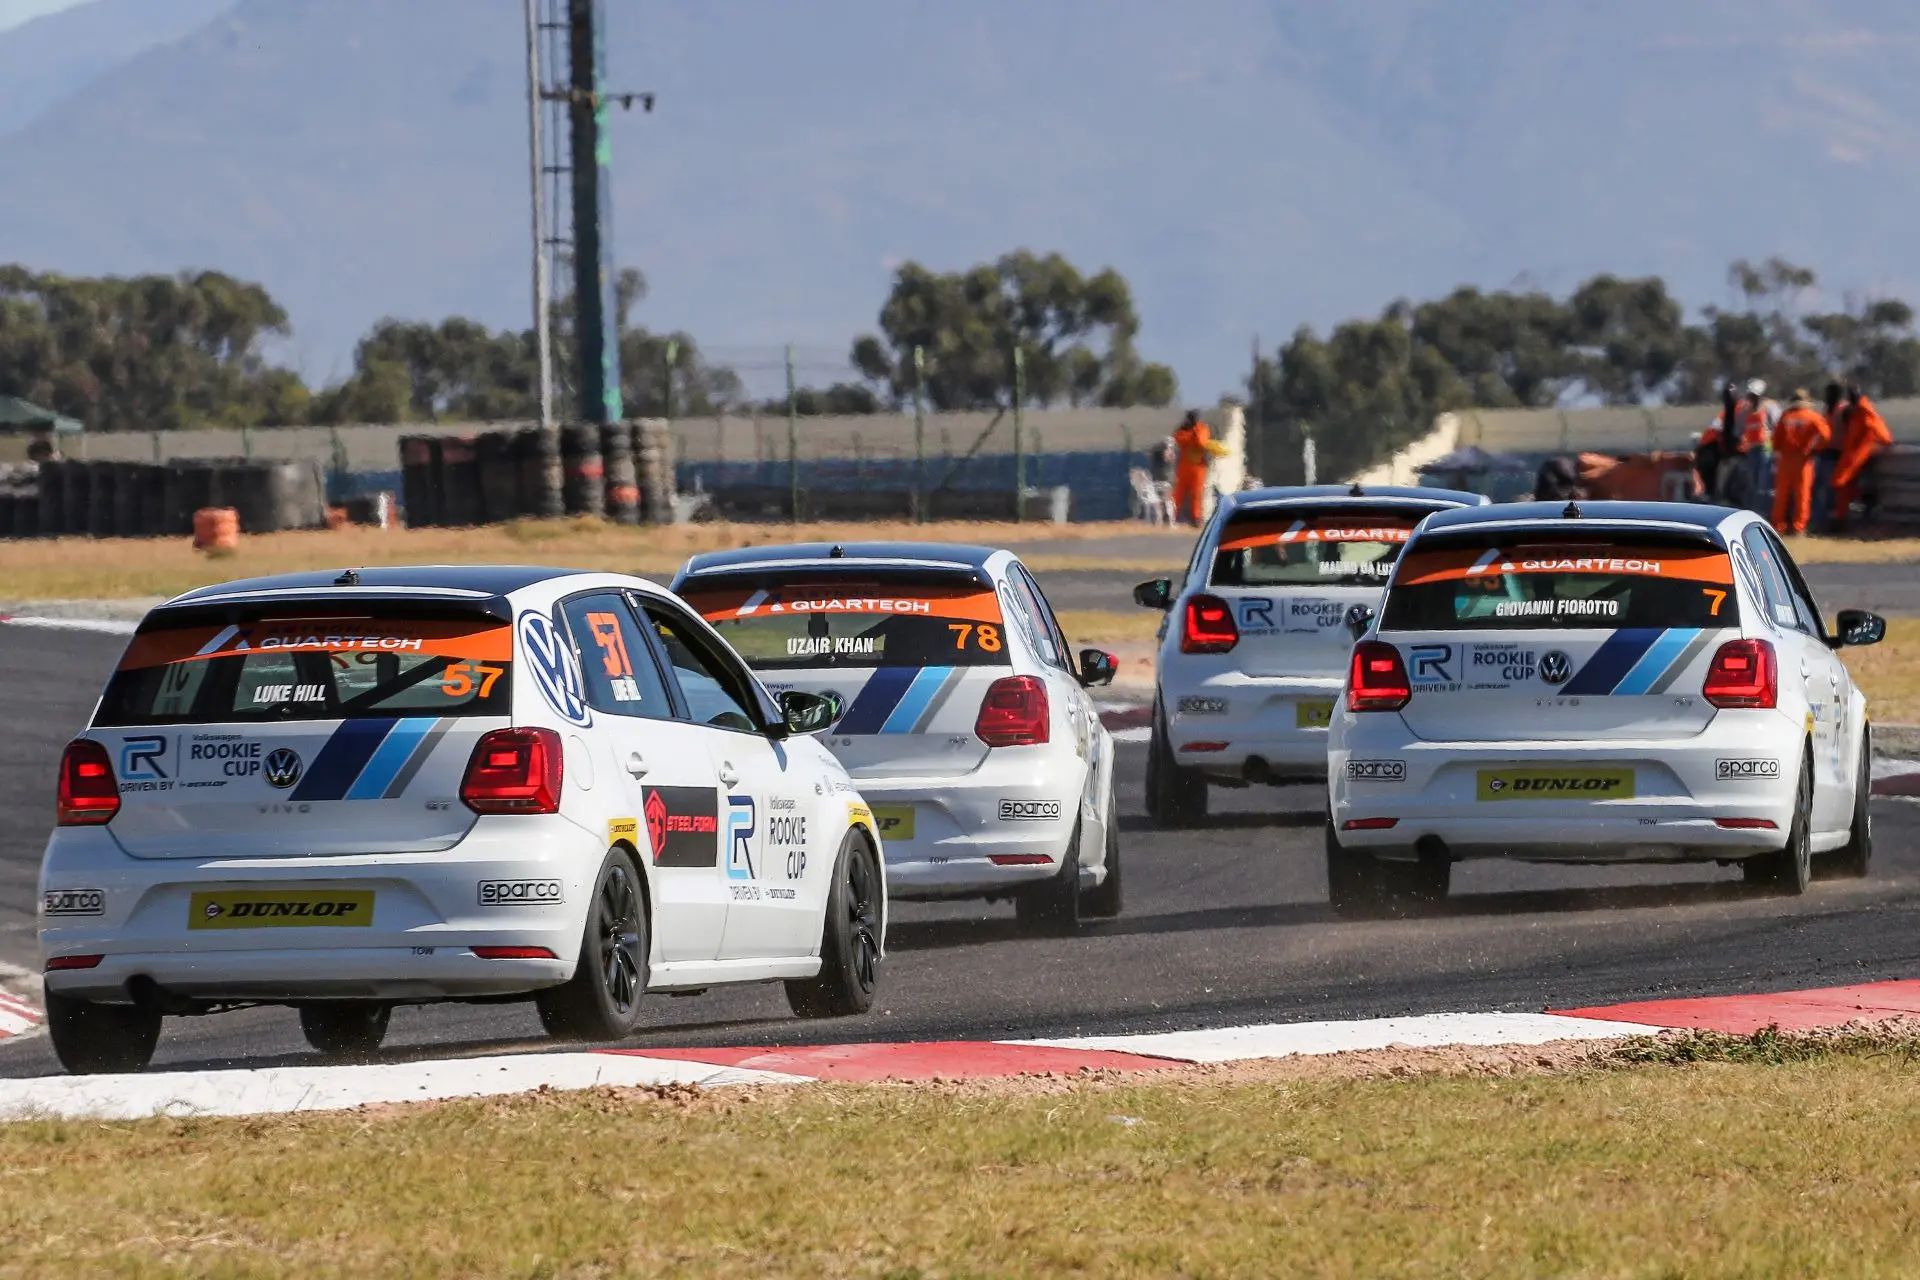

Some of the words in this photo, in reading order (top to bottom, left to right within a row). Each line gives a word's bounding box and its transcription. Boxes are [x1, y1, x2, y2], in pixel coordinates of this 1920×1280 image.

[1324, 529, 1412, 540] QUARTE
[1521, 558, 1661, 573] QUARTECH
[791, 598, 930, 613] QUARTECH
[1291, 603, 1345, 616] ROOKIE
[1496, 599, 1553, 617] GIOVANNI
[1557, 599, 1618, 616] FIOROTTO
[1703, 588, 1727, 616] 7
[260, 635, 424, 651] QUARTECH
[948, 623, 1002, 652] 78
[787, 637, 831, 655] UZAIR
[834, 637, 874, 654] KHAN
[1473, 651, 1535, 666] ROOKIE
[441, 664, 504, 698] 57
[1502, 667, 1535, 681] CUP
[253, 684, 291, 703] LUKE
[293, 684, 326, 702] HILL
[1413, 683, 1448, 694] DRIVEN
[190, 743, 262, 760] ROOKIE
[223, 761, 261, 777] CUP
[1347, 762, 1403, 780] sparco
[1719, 760, 1778, 779] sparco
[120, 781, 158, 793] DRIVEN
[159, 780, 175, 791] BY
[1512, 778, 1621, 791] DUNLOP
[1001, 801, 1060, 819] sparco
[769, 816, 806, 846] ROOKIE
[787, 851, 806, 880] CUP
[483, 882, 560, 903] sparco
[228, 902, 358, 918] DUNLOP
[411, 946, 435, 956] TOW
